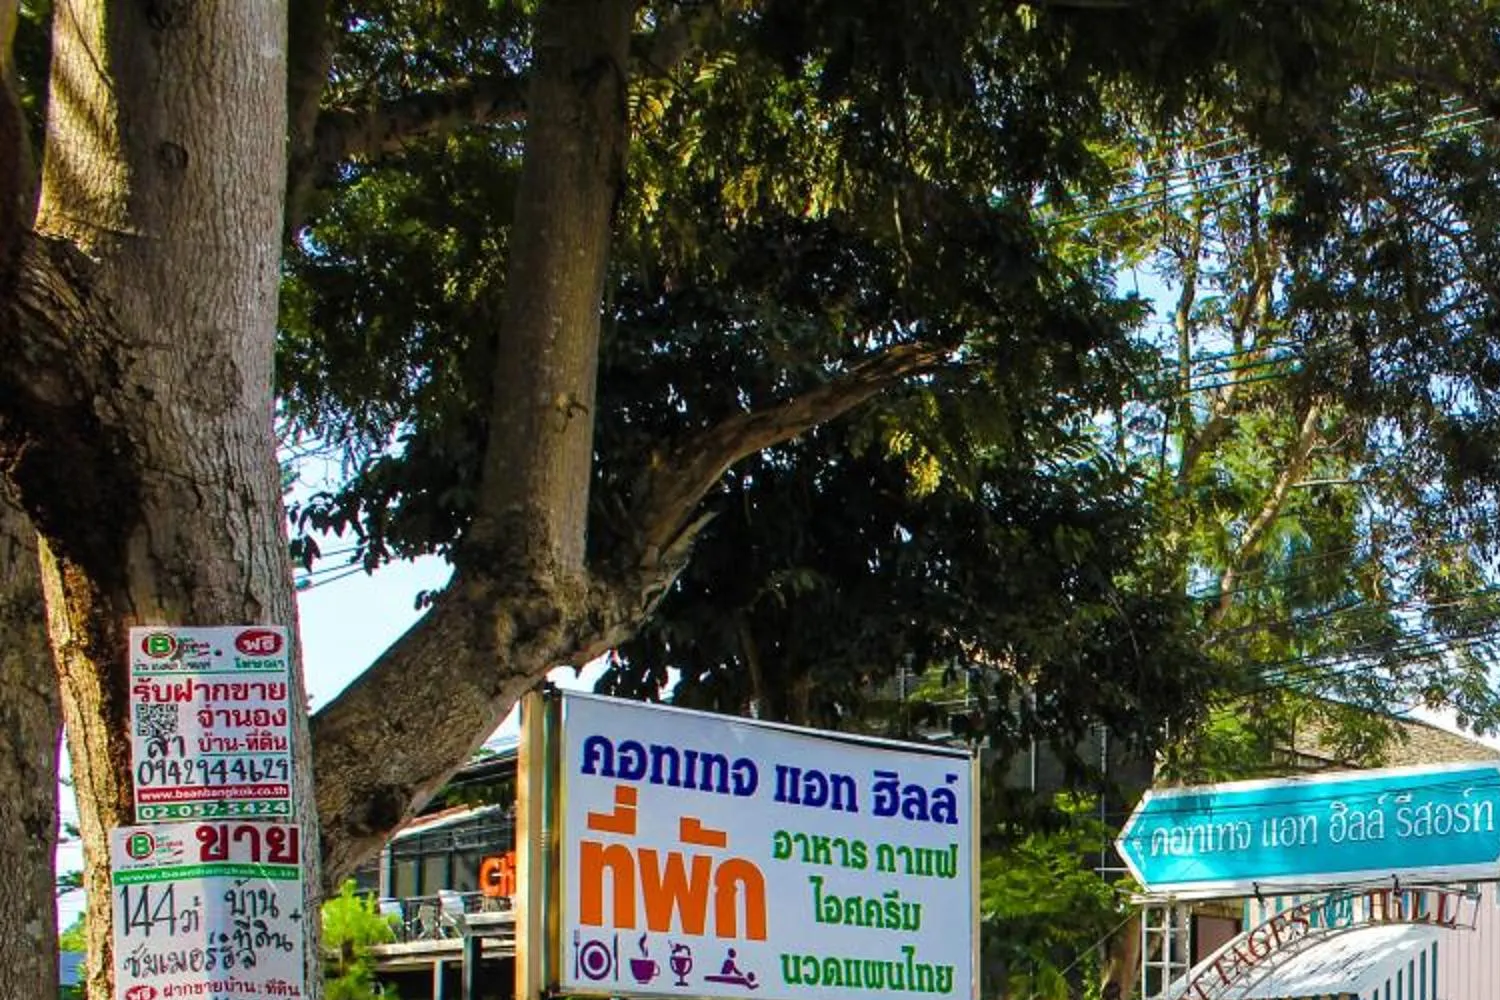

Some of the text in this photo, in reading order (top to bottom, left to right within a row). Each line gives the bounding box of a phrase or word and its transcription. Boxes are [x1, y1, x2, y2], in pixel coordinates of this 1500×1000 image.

[132, 677, 287, 703] รับฝากขาย
[197, 704, 288, 728] จำนอง
[580, 734, 959, 825] คอทเทจ แอท ฮิลล์
[141, 802, 288, 819] 02-057-5424
[1262, 813, 1318, 849] แอท
[1329, 793, 1385, 843] ฮิลล์
[1395, 787, 1495, 839] รีสอร์ท
[195, 824, 300, 865] ขาย
[579, 784, 768, 941] ที่พัก
[772, 828, 959, 879] อาหาร กาแฟ
[809, 875, 921, 932] ไอศครีม
[780, 945, 954, 994] นวดแผนไทย
